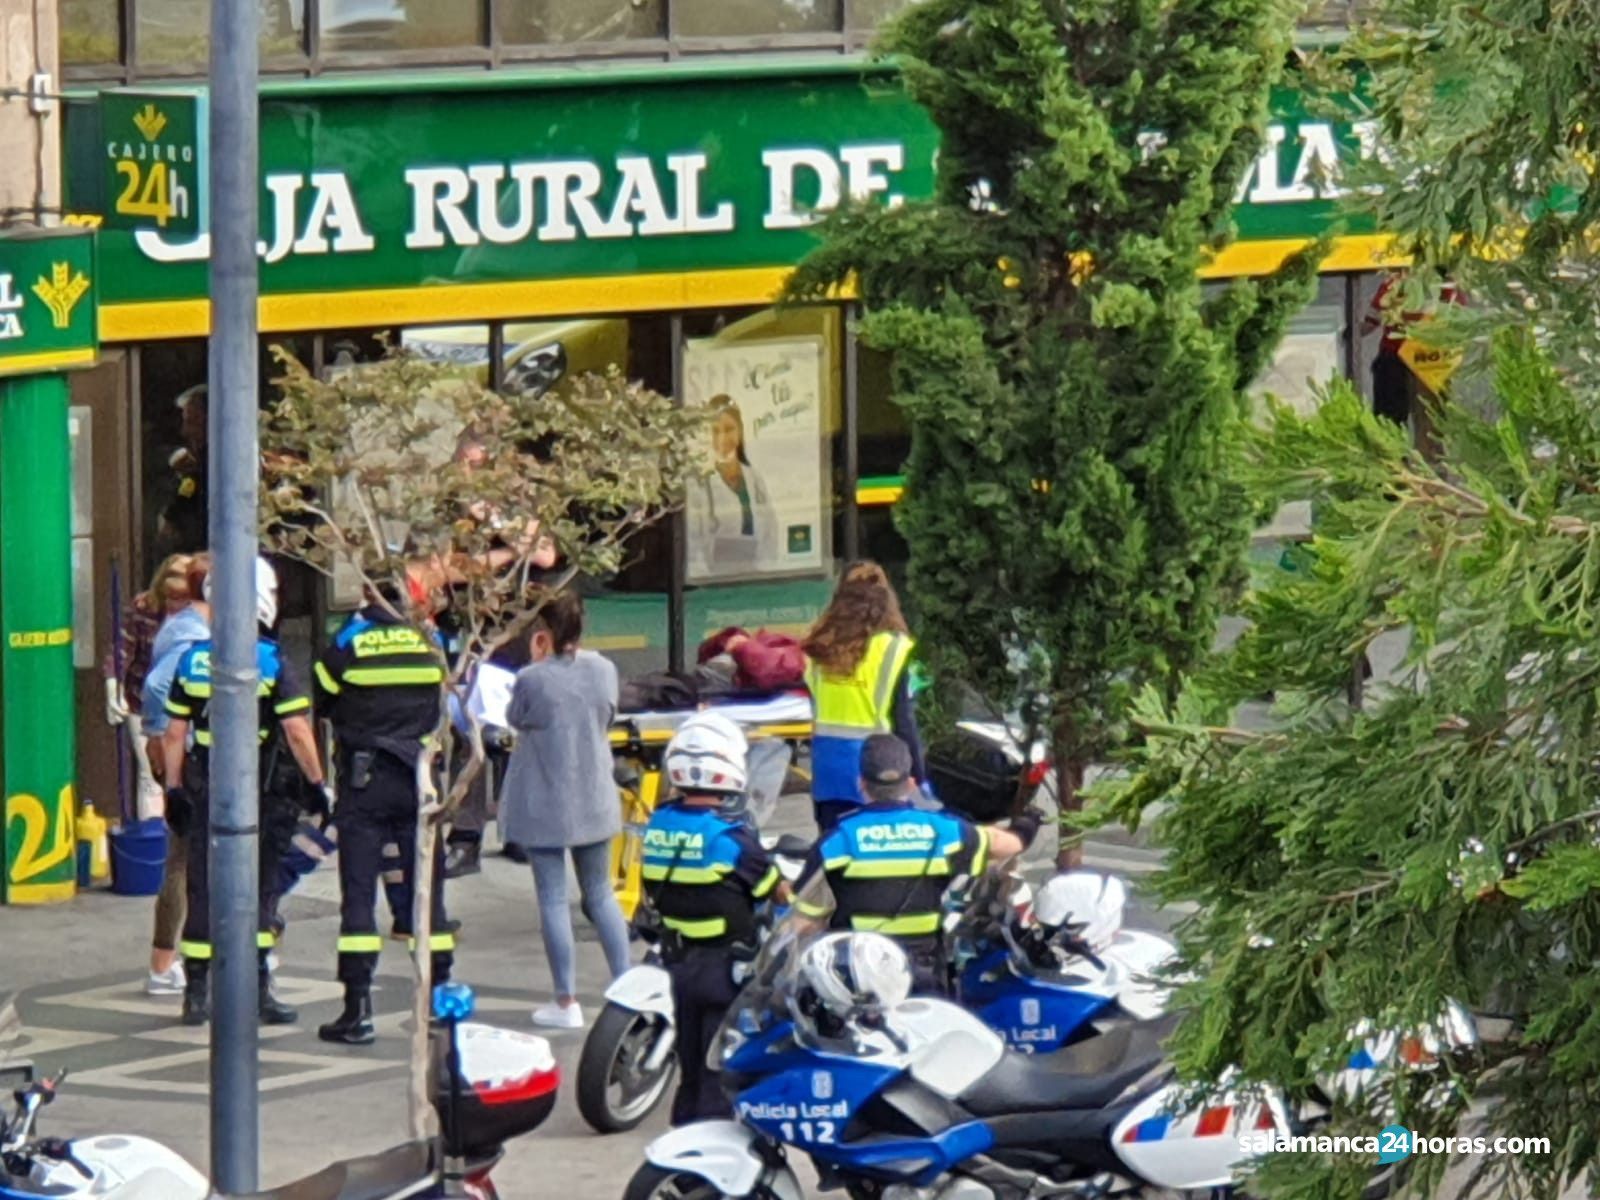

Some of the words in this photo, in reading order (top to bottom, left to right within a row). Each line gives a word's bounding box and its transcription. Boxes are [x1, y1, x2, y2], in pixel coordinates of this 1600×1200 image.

[107, 141, 192, 162] CAJERO
[116, 160, 189, 226] 24h
[404, 154, 734, 249] RURAL
[643, 828, 704, 848] POLICIA
[855, 822, 936, 842] POLICIA
[1011, 1024, 1057, 1042] Local
[800, 1099, 848, 1119] Local
[780, 1121, 835, 1144] 112
